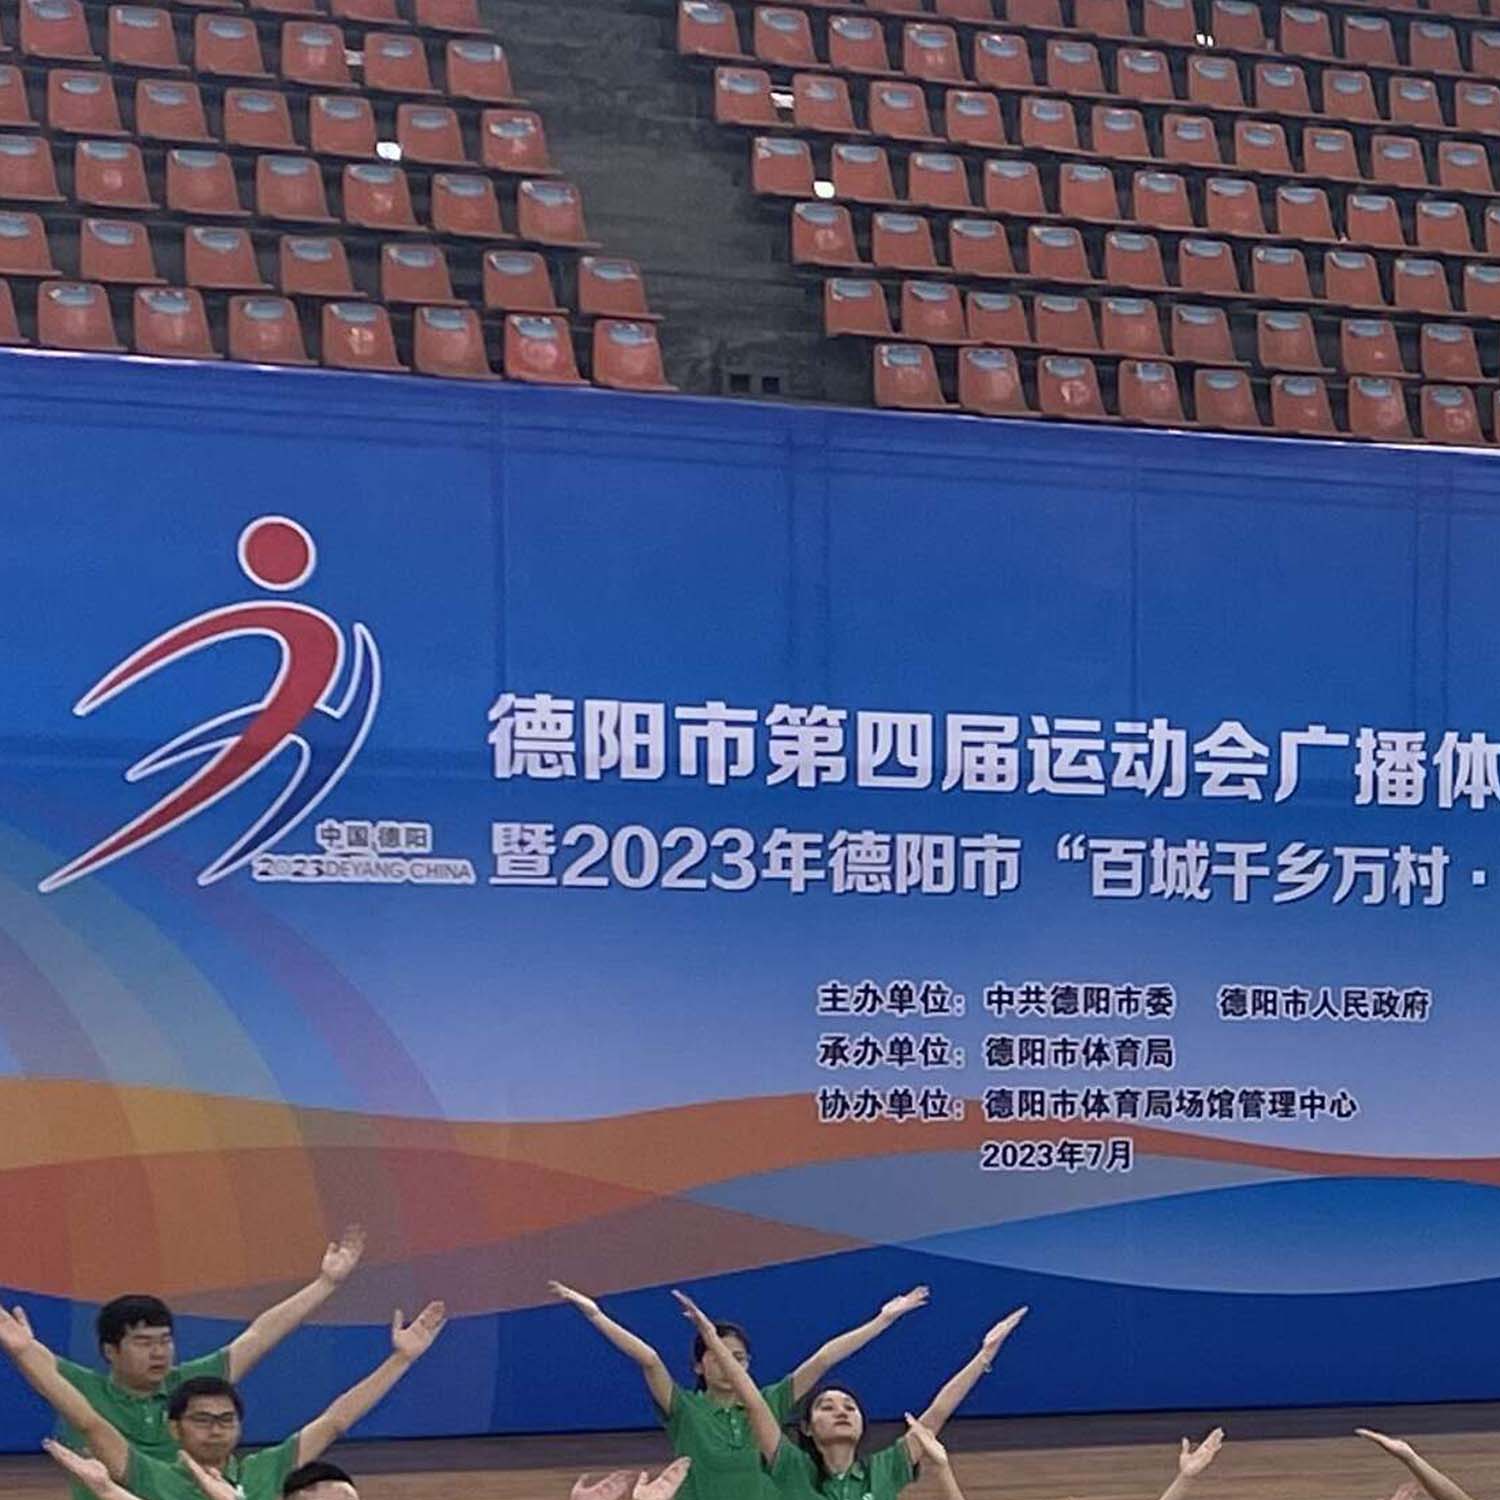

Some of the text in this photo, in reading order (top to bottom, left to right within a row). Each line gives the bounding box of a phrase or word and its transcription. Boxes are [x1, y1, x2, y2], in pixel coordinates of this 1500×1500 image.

[1219, 985, 1430, 1020] 德阳市人民政府
[982, 1139, 1132, 1171] 2023年7月
